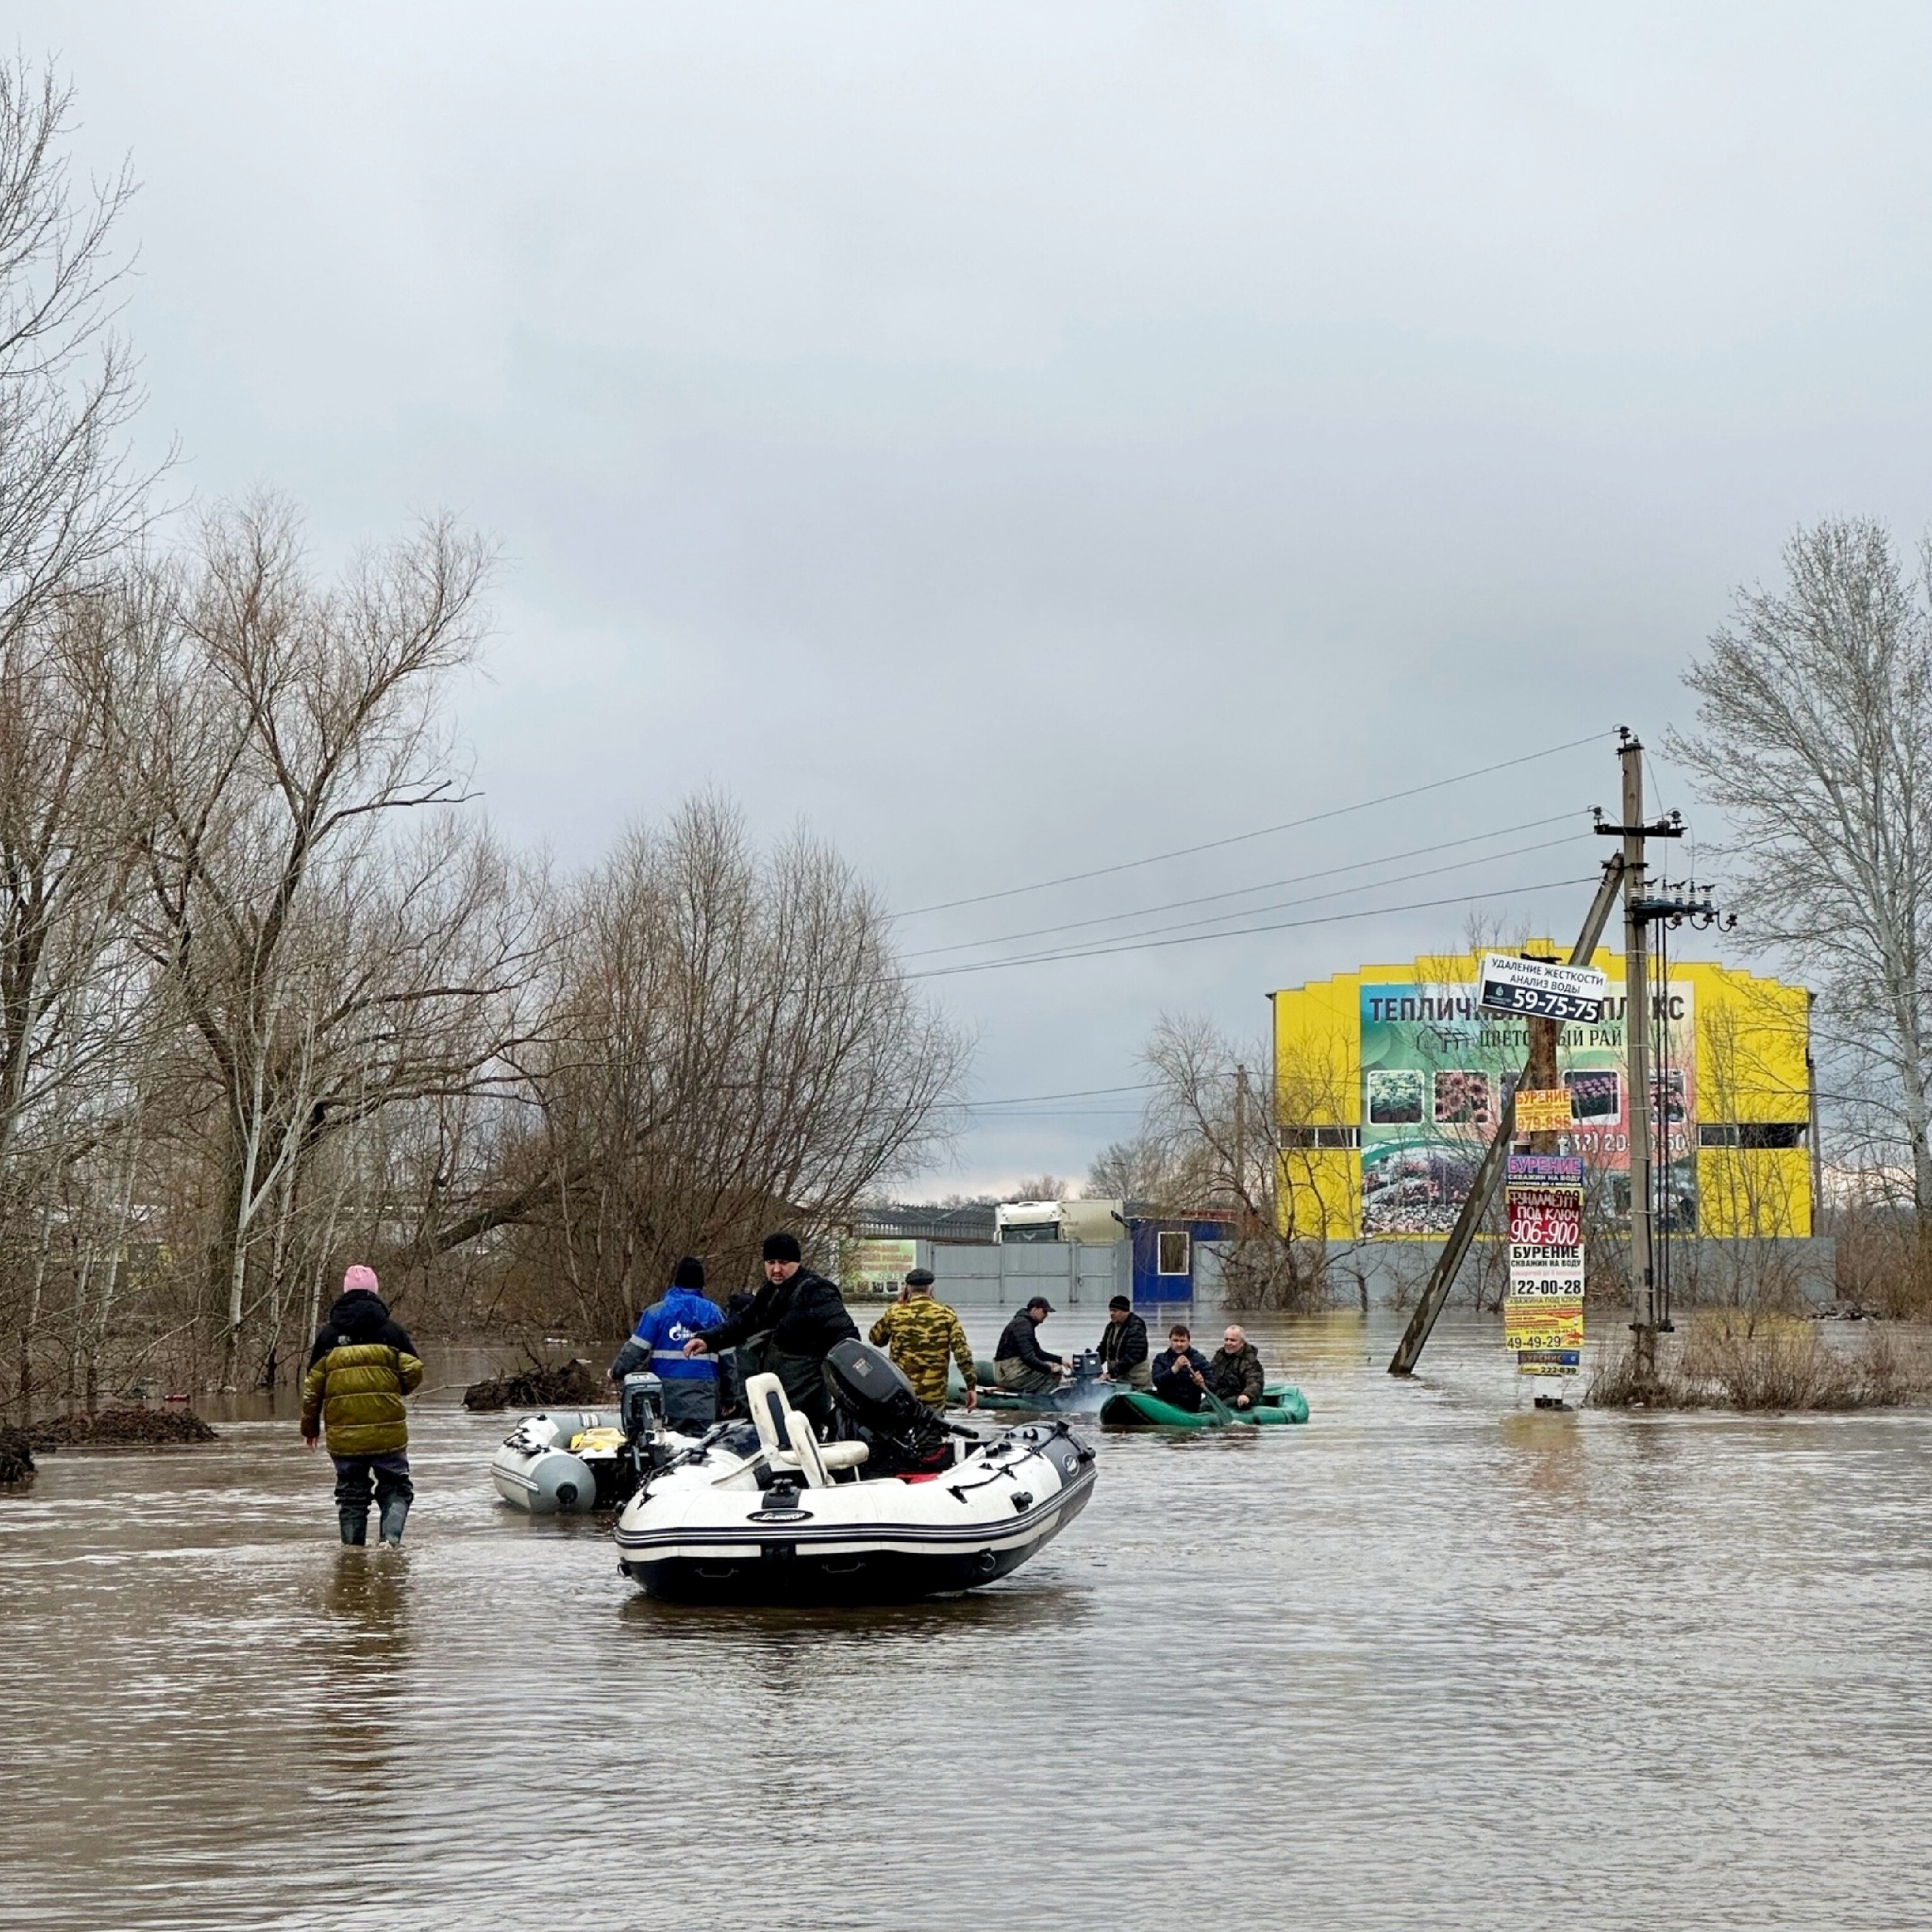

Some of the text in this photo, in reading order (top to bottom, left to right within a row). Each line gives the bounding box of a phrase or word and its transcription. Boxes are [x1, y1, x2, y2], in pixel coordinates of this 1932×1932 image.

[1492, 958, 1603, 986] УДАЛЕНИЕ ЖЕСТКОСТИ
[1510, 974, 1581, 994] АНАЛИЗ ВОДЫ
[1512, 989, 1598, 1021] 59-75-75
[1590, 1026, 1622, 1046] РАЙ
[1517, 1090, 1570, 1104] БУРЕНИЕ
[1507, 1156, 1582, 1175] БУРЕНИЕ
[1509, 1191, 1577, 1208] ФУНДАМЕНТ
[1517, 1206, 1579, 1222] ПОД КЛЮЧ
[1510, 1220, 1579, 1245] 906-900
[1513, 1246, 1580, 1259] БУРЕНИЕ
[1518, 1280, 1581, 1294] 22-00-28
[1507, 1336, 1561, 1349] 49-49-29
